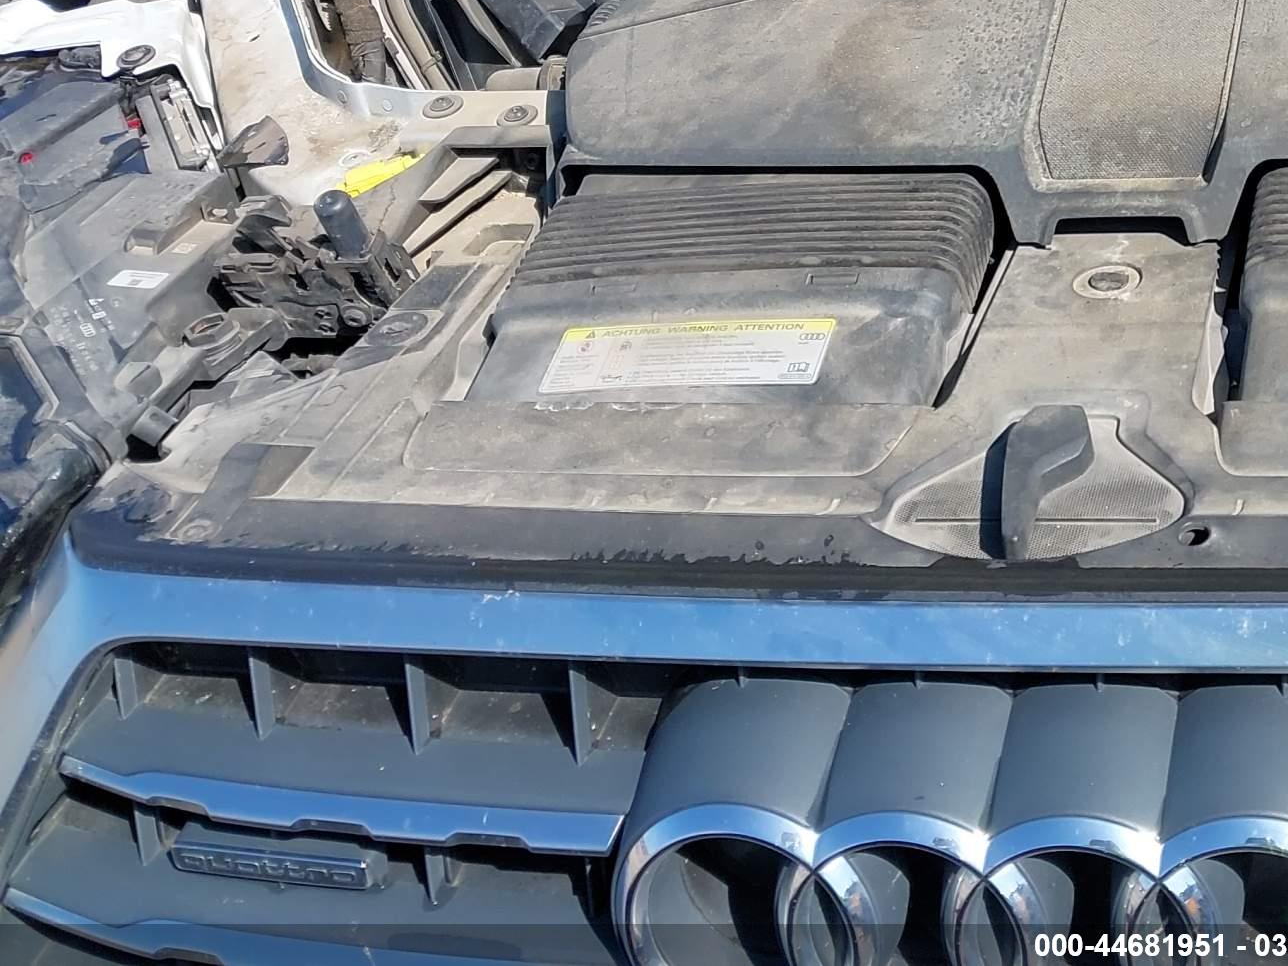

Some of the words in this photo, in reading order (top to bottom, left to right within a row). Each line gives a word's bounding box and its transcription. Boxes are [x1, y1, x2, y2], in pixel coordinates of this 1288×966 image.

[601, 327, 662, 339] ACHTUNG
[667, 323, 729, 335] WARNING
[733, 321, 806, 332] ATTENTION
[179, 853, 356, 882] quattro
